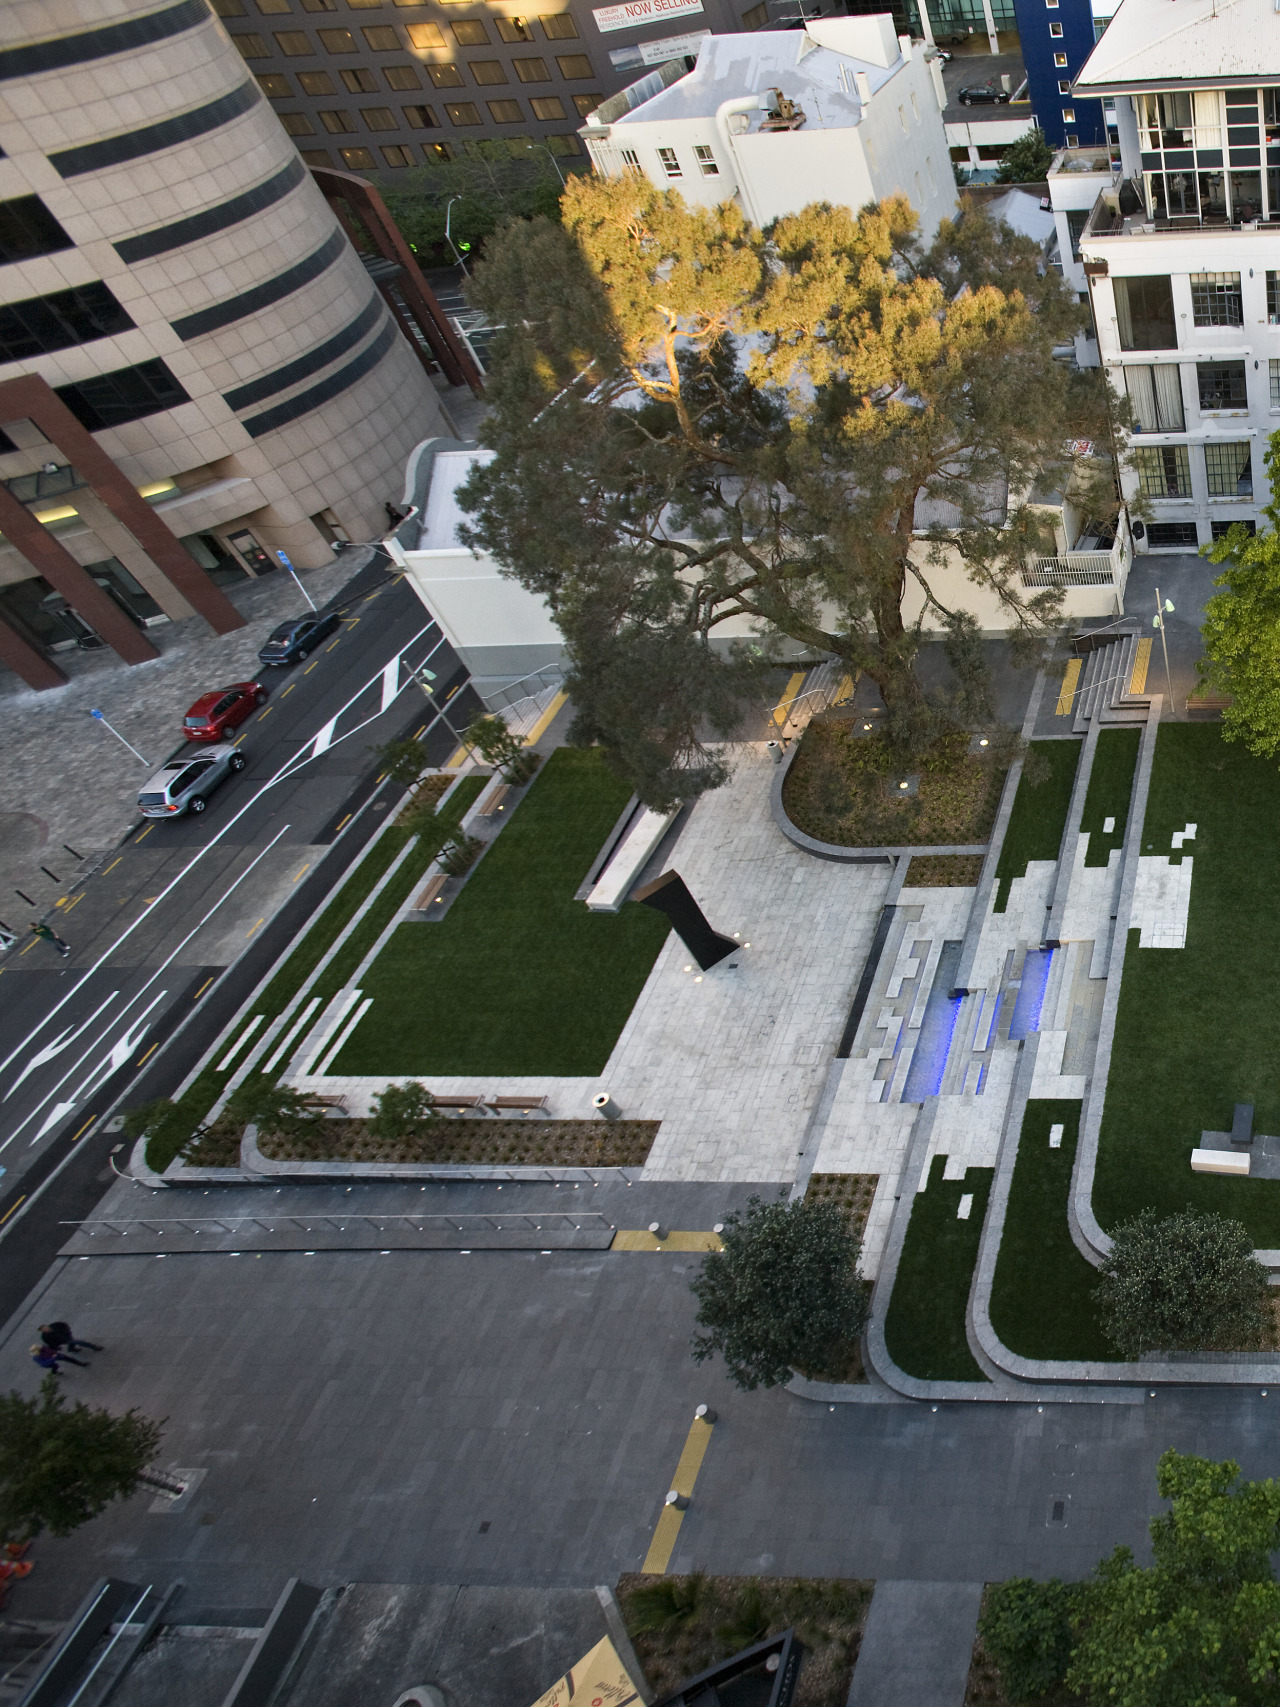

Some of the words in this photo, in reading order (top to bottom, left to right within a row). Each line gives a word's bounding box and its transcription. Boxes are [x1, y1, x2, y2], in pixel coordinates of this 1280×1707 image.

[599, 8, 619, 17] LUXURY
[624, 2, 652, 17] NOW
[599, 13, 625, 23] FREEHOLD
